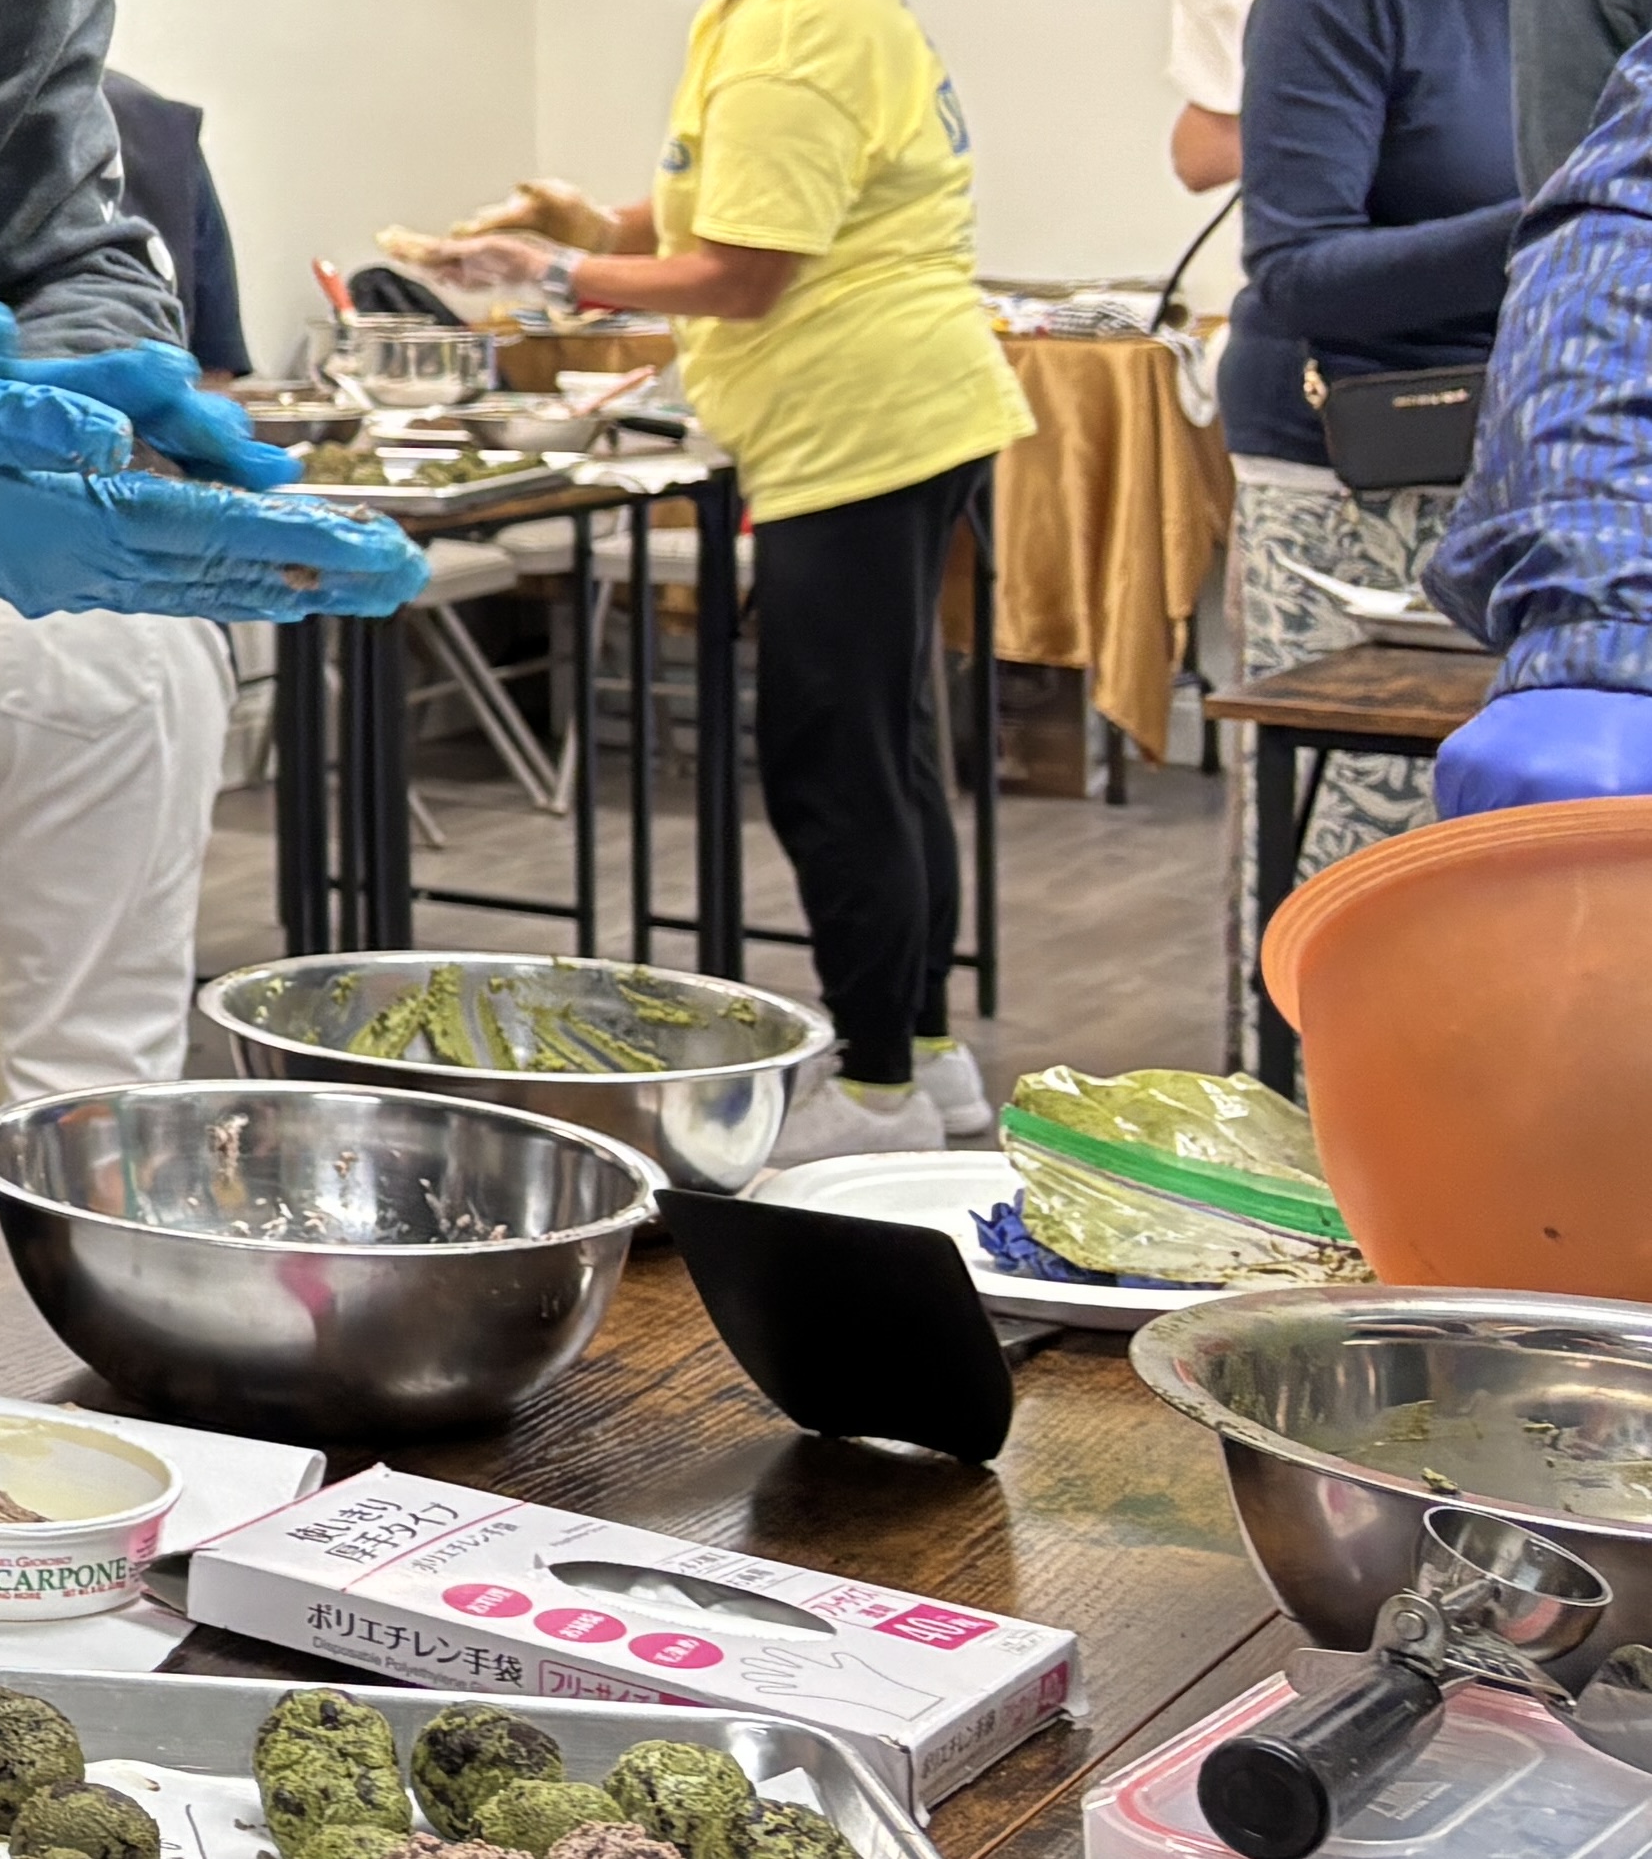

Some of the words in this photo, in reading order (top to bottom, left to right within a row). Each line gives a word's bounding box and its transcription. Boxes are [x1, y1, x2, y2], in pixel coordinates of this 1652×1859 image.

[286, 1498, 402, 1544] 使いきり
[324, 1502, 459, 1565] 厚手タイプ
[307, 1603, 524, 1688] ポリエチレン手袋
